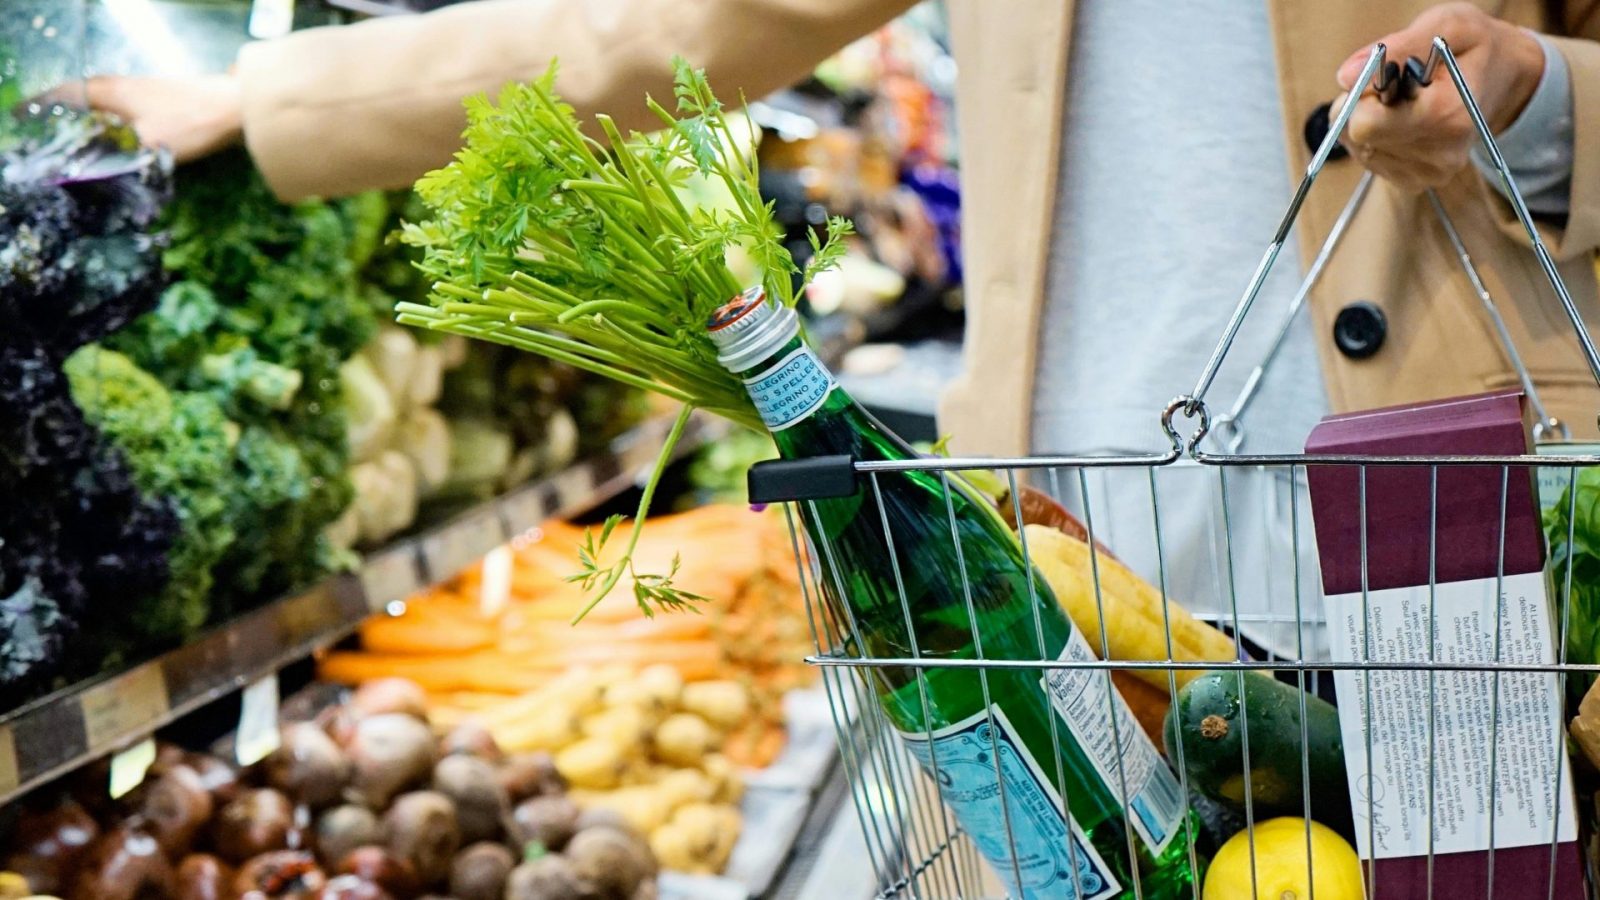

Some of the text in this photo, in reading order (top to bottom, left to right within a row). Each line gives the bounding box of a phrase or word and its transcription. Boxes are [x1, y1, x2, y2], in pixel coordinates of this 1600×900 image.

[1401, 600, 1410, 617] Seul
[1420, 603, 1428, 614] de
[1519, 596, 1529, 630] delicious
[1529, 602, 1537, 612] At
[1373, 606, 1384, 641] Délicieux
[1404, 620, 1410, 630] un
[1453, 616, 1463, 645] cheese
[1471, 610, 1480, 632] these
[1529, 614, 1540, 640] Lesley
[1350, 634, 1356, 645] ne
[1394, 626, 1407, 662] supérieu
[1404, 632, 1416, 659] produit
[1504, 628, 1512, 642] her
[1365, 621, 1378, 676] accompags
[1378, 644, 1384, 654] au
[1434, 642, 1443, 662] Stow
[1457, 647, 1463, 655] or
[1473, 634, 1484, 661] unique
[1484, 640, 1493, 662] CRIS
[1506, 644, 1515, 664] team
[1534, 642, 1543, 663] Stow
[1410, 661, 1420, 688] ison
[1526, 653, 1535, 678] The
[1049, 668, 1073, 691] Nutri
[1374, 677, 1381, 687] de
[1400, 670, 1412, 698] pouvait
[1438, 670, 1446, 686] ine
[1479, 670, 1488, 696] ackers
[1510, 671, 1518, 684] ink
[1538, 672, 1546, 686] ine
[1440, 688, 1450, 712] Foods
[1462, 616, 1487, 762] but really she when topped with your
[1501, 676, 1511, 705] scratch
[1529, 680, 1540, 712] fabulous
[1540, 688, 1550, 712] Foods
[1412, 690, 1424, 723] fabriqué
[1464, 696, 1472, 709] We
[1512, 701, 1522, 717] only
[1520, 678, 1528, 694] with
[1526, 724, 1535, 745] small
[1384, 702, 1397, 742] craquelins
[1386, 639, 1416, 808] CRAEZ POUR CES FINS CRAQUELINS
[1406, 700, 1417, 734] satisfaire
[1417, 652, 1424, 662] en
[1436, 791, 1444, 800] de
[1434, 704, 1444, 737] fabuleux
[1444, 714, 1453, 736] adore
[1451, 671, 1460, 687] ood
[1458, 731, 1466, 746] you
[1463, 761, 1471, 772] be
[1483, 712, 1492, 730] grea
[1504, 706, 1514, 728] using
[1514, 719, 1523, 735] way
[1532, 714, 1543, 738] crisps
[1544, 714, 1550, 725] we
[1380, 729, 1388, 740] de
[1468, 726, 1478, 759] addicted
[1518, 736, 1525, 744] to
[1545, 727, 1554, 744] love
[1381, 741, 1393, 774] fromage
[1391, 744, 1400, 760] sont
[1409, 737, 1420, 761] Lesley
[1421, 744, 1429, 759] des
[1437, 739, 1450, 778] craquelins
[1446, 738, 1458, 772] fabriquer
[1510, 744, 1519, 765] finest
[1519, 746, 1528, 768] make
[1537, 740, 1546, 758] from
[1414, 763, 1422, 771] et
[1472, 760, 1479, 768] to
[1538, 759, 1550, 791] Lesley's
[1387, 775, 1393, 785] ou
[1394, 762, 1406, 805] irrésistibles
[1473, 770, 1482, 784] this
[1522, 777, 1532, 797] great
[1444, 781, 1452, 797] sont
[1474, 786, 1484, 814] yummy
[1445, 799, 1457, 834] fabriqués
[1456, 804, 1464, 821] offrir
[1525, 798, 1536, 828] product
[1544, 792, 1554, 820] kitchen
[1398, 807, 1411, 841] lorsqu'ils
